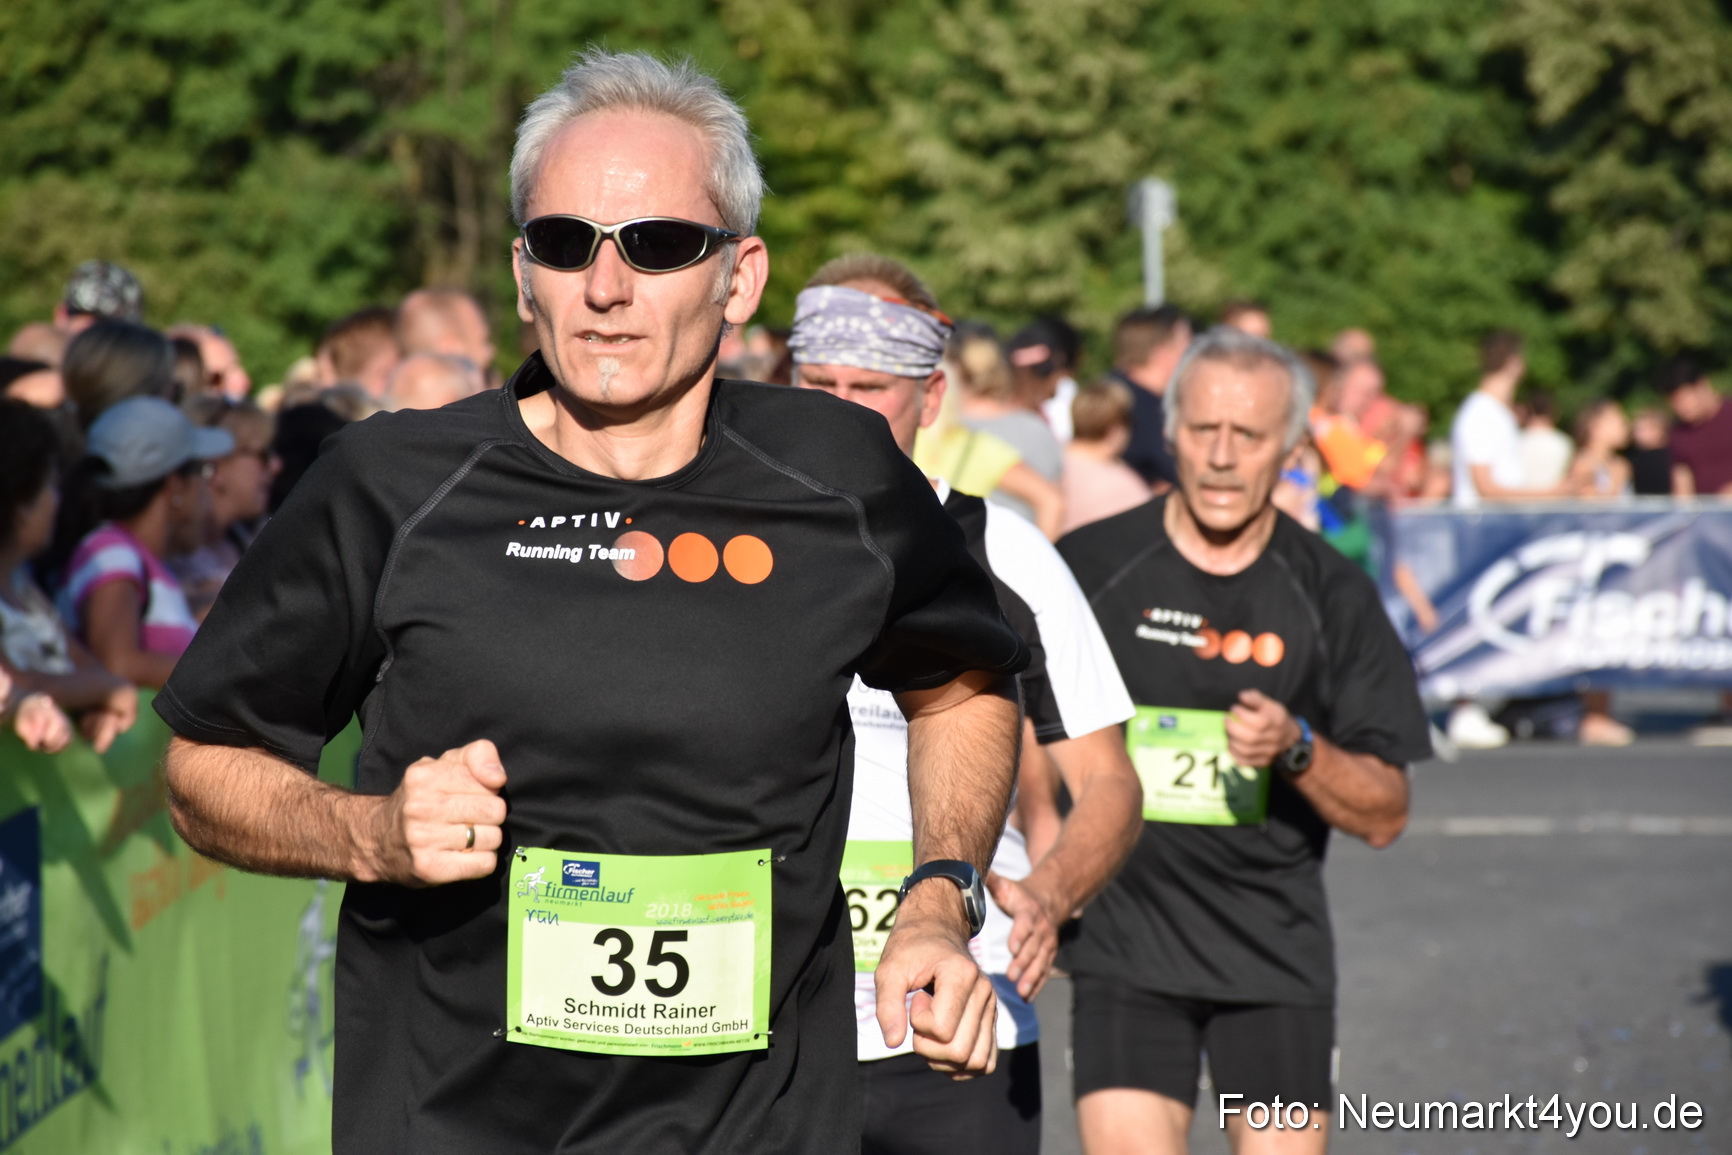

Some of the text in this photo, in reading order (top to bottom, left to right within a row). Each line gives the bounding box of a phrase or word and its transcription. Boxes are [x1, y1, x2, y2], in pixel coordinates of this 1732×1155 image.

[530, 511, 620, 528] APTIV
[506, 542, 636, 563] Running Team
[1172, 752, 1219, 790] 21
[545, 882, 635, 904] firmenlauf
[545, 899, 583, 907] neumarkt
[645, 903, 693, 918] 2018
[590, 928, 690, 998] 35
[564, 998, 717, 1019] Schmidt Rainer
[526, 1013, 749, 1036] Aptiv Services Deutschland GmbH
